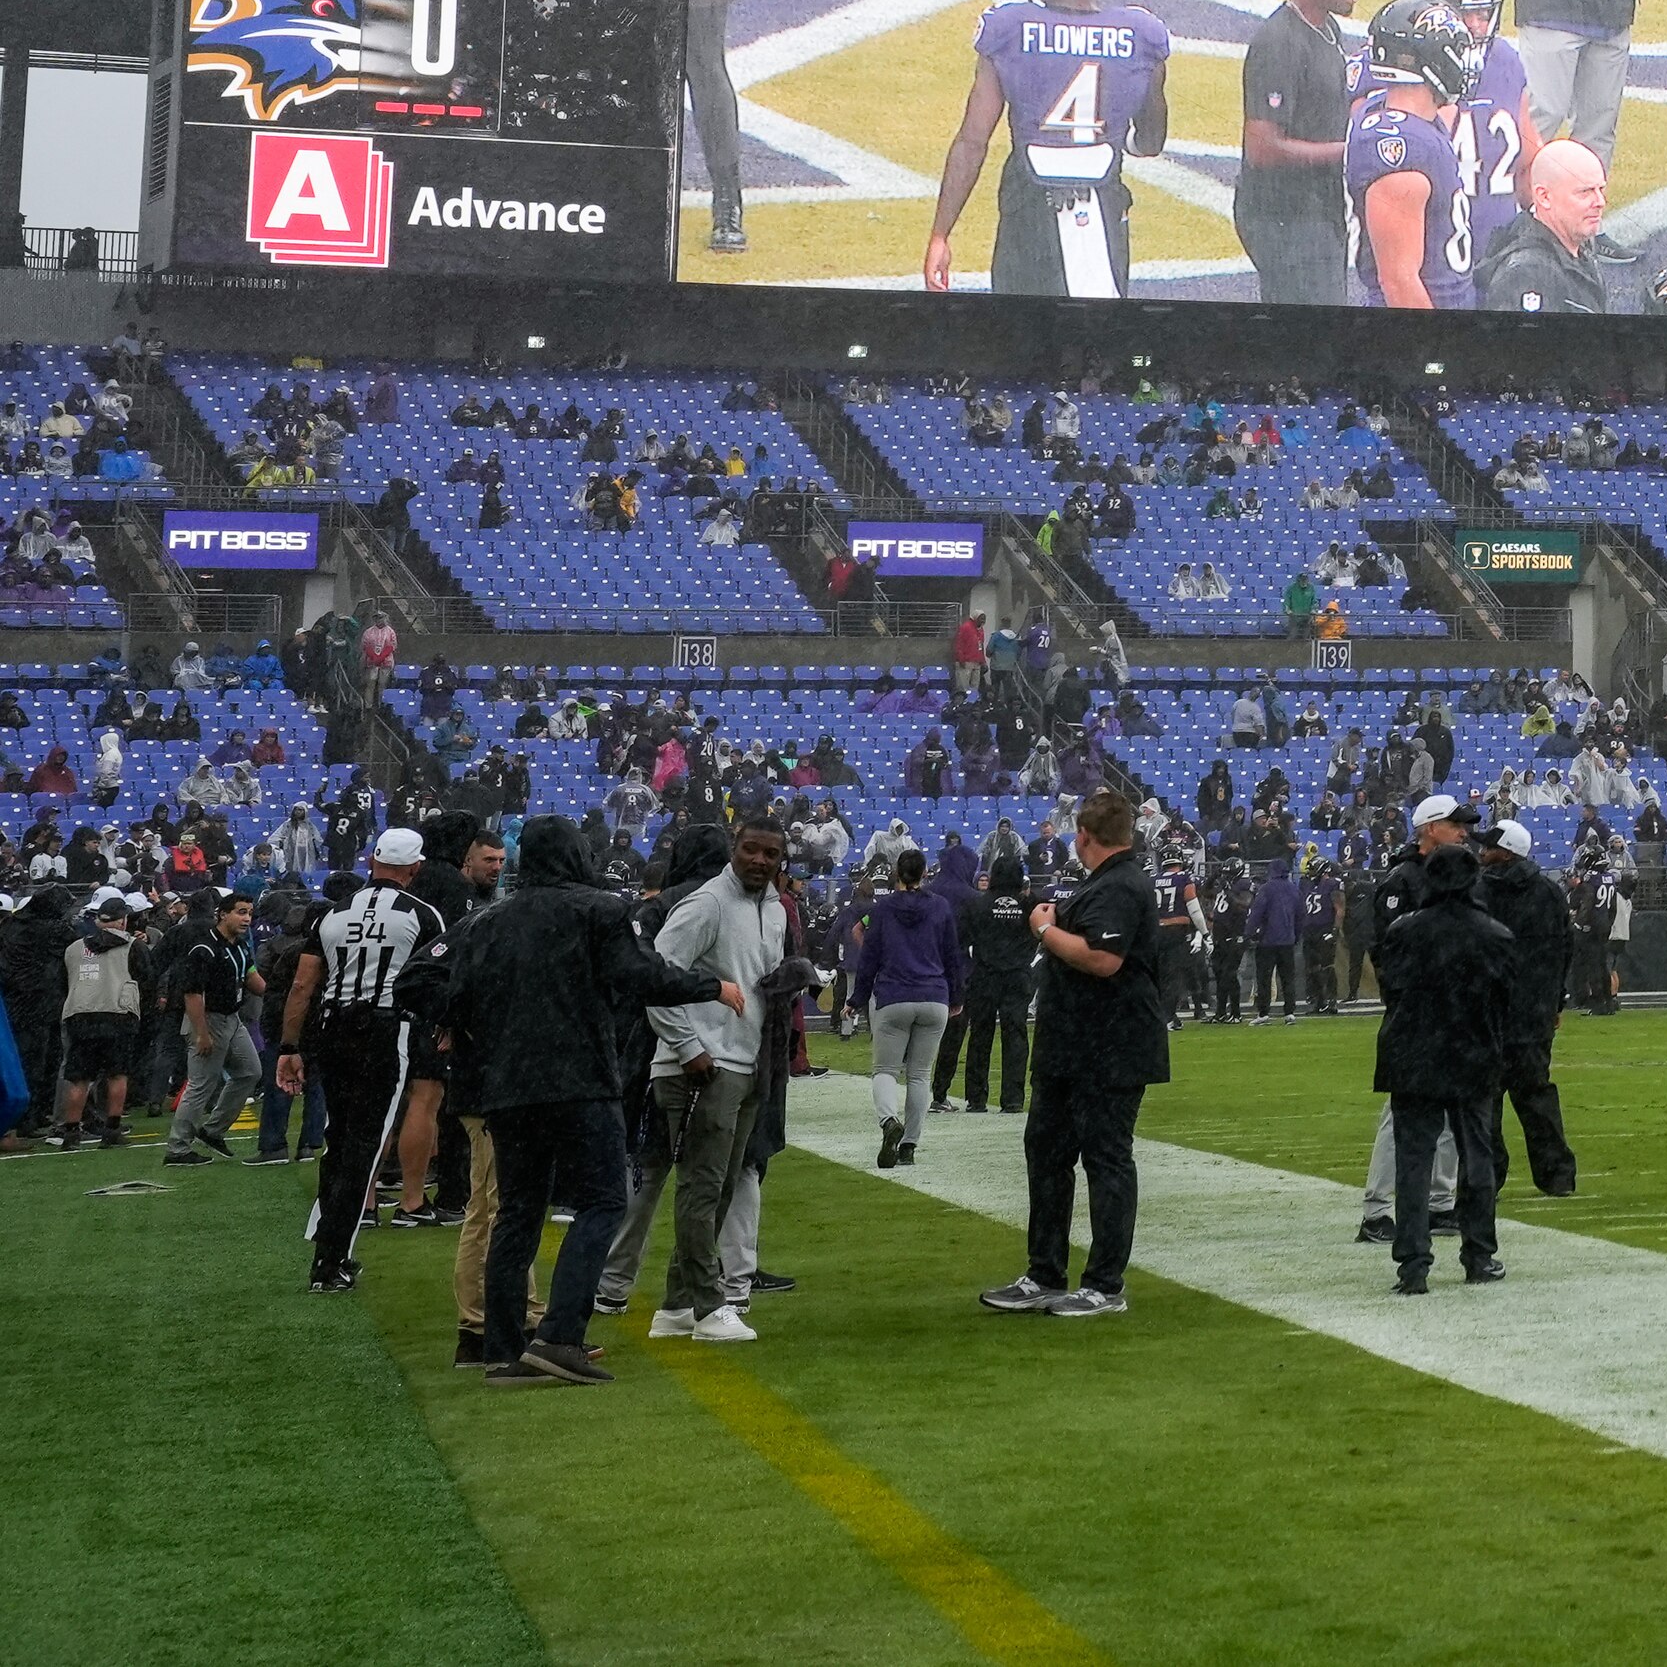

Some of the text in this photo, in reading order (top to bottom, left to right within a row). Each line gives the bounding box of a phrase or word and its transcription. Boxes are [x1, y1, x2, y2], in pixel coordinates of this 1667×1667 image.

[1022, 21, 1133, 58] FLOWERS
[1040, 62, 1107, 146] 4
[1454, 114, 1521, 196] 42
[263, 149, 607, 236] A Advance
[1437, 401, 1449, 413] 29
[283, 424, 297, 436] 44
[1106, 498, 1120, 508] 32
[168, 531, 307, 550] PIT BOSS
[852, 539, 975, 557] PIT BOSS
[1491, 542, 1540, 555] CAESARS
[1491, 553, 1573, 570] SPORTSBOOK
[681, 643, 714, 666] 138
[1320, 646, 1348, 668] 139
[1015, 718, 1024, 730] 8
[701, 742, 715, 756] 20
[705, 788, 713, 803] 8
[363, 910, 376, 921] R
[992, 907, 1022, 915] RAVENS
[346, 922, 385, 944] 34
